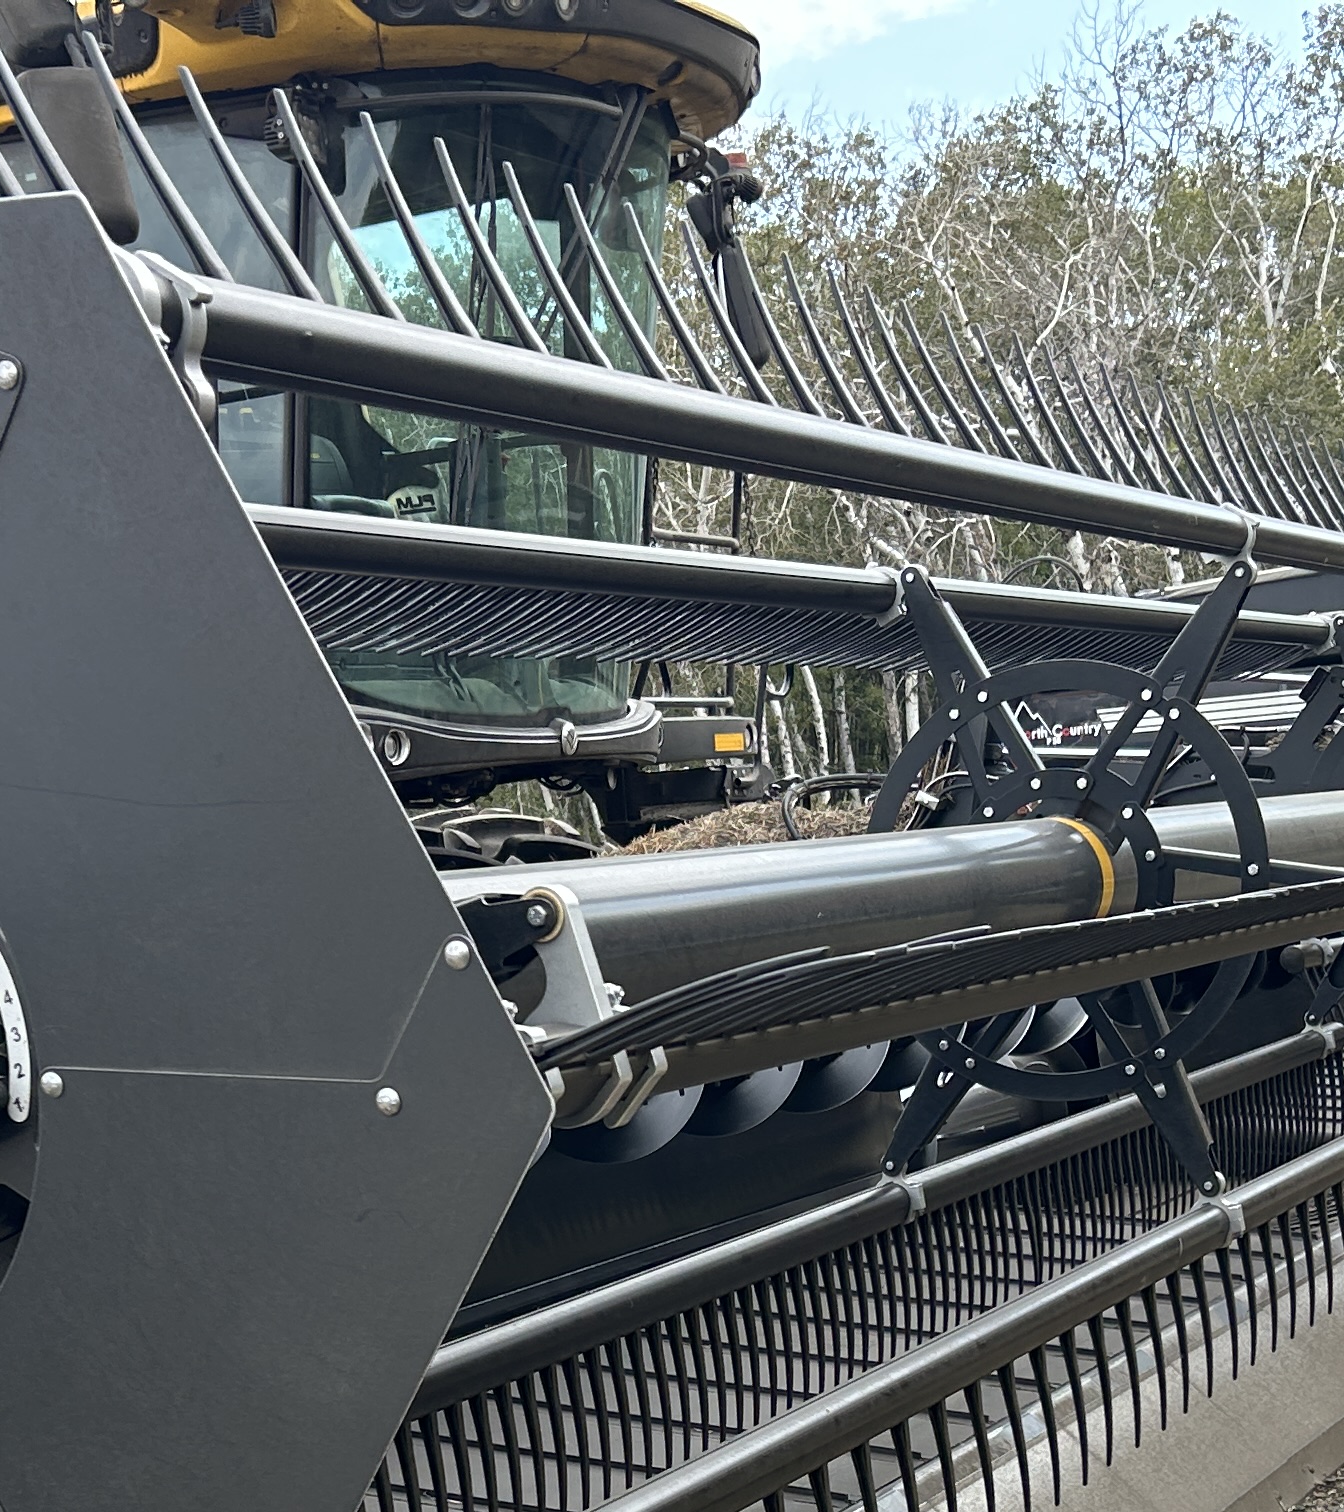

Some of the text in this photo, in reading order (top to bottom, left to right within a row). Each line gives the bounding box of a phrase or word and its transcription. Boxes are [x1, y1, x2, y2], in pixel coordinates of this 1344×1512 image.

[1052, 724, 1102, 737] Country
[4, 989, 13, 1004] 4
[10, 1026, 22, 1043] 3
[13, 1062, 26, 1080] 2
[13, 1097, 24, 1113] 1
